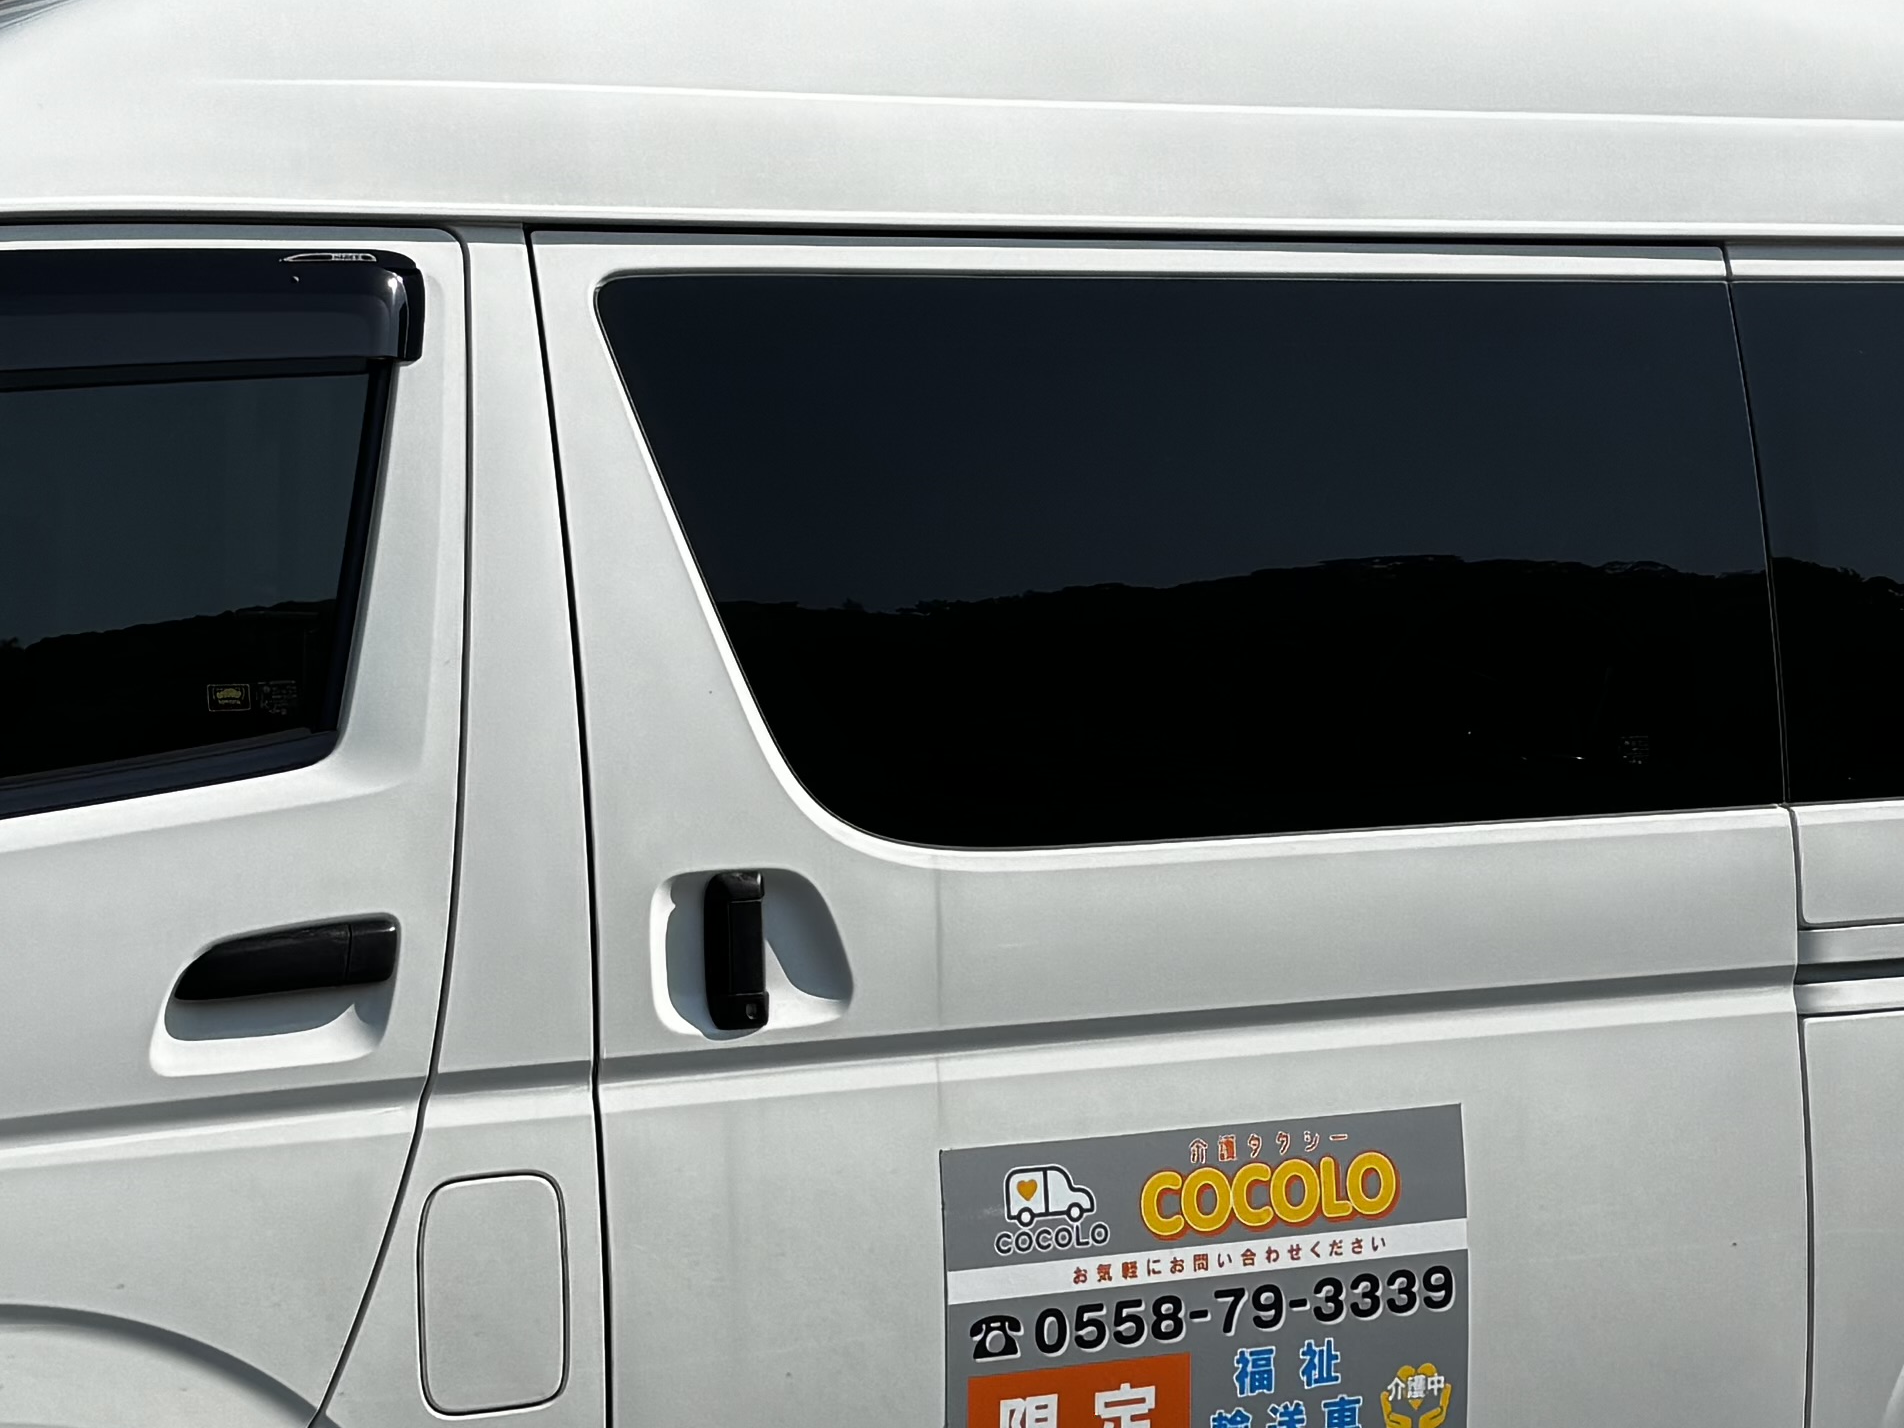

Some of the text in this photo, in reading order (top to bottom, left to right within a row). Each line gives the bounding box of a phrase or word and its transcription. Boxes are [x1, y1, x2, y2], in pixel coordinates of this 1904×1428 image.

[1189, 1130, 1350, 1163] 介護タクシー
[1140, 1149, 1400, 1240] COCOLO
[995, 1223, 1110, 1256] COCOLO
[1072, 1235, 1387, 1285] お気軽にお問い合わせください
[1034, 1264, 1456, 1358] 0558-79-3339
[1233, 1338, 1341, 1397] 福祉
[1386, 1373, 1446, 1400] 介護中
